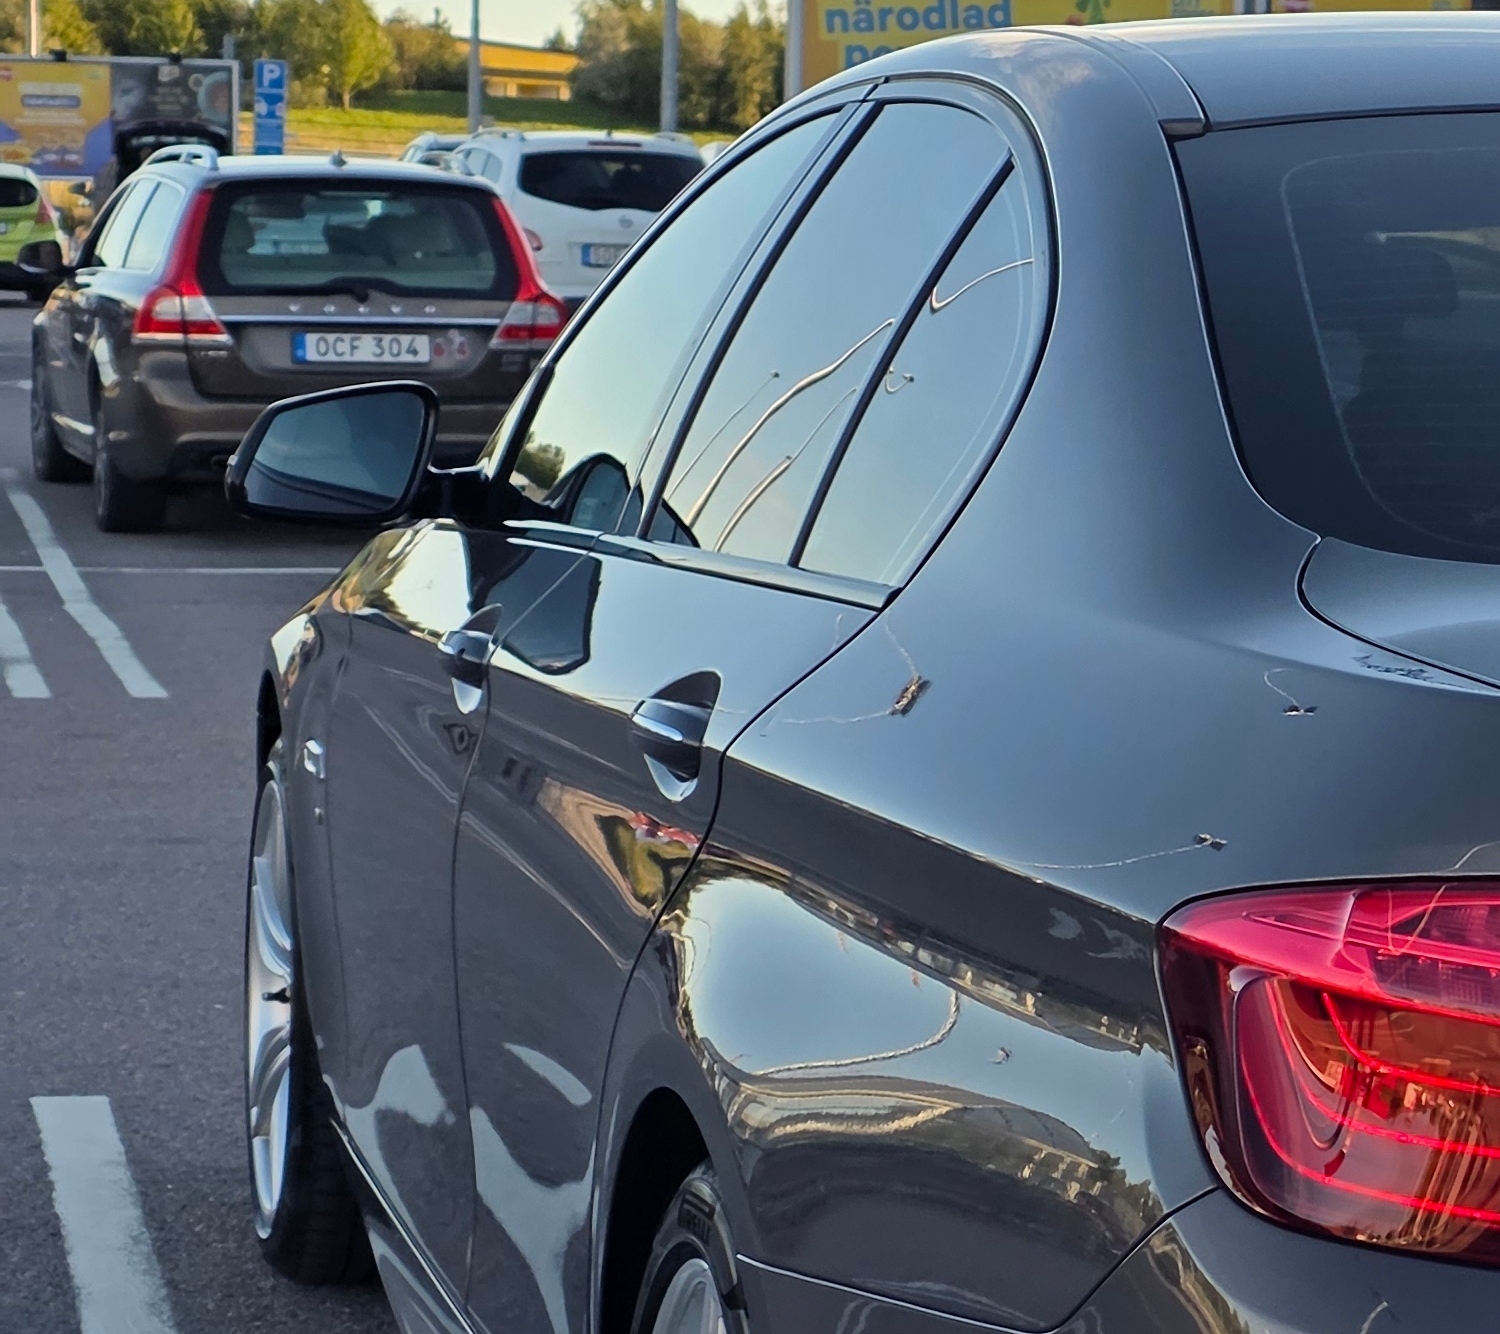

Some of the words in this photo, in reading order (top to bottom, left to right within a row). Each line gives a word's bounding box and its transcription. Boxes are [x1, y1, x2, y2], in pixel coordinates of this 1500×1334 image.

[262, 63, 280, 87] P
[315, 335, 362, 358] OCF
[371, 335, 420, 358] 304
